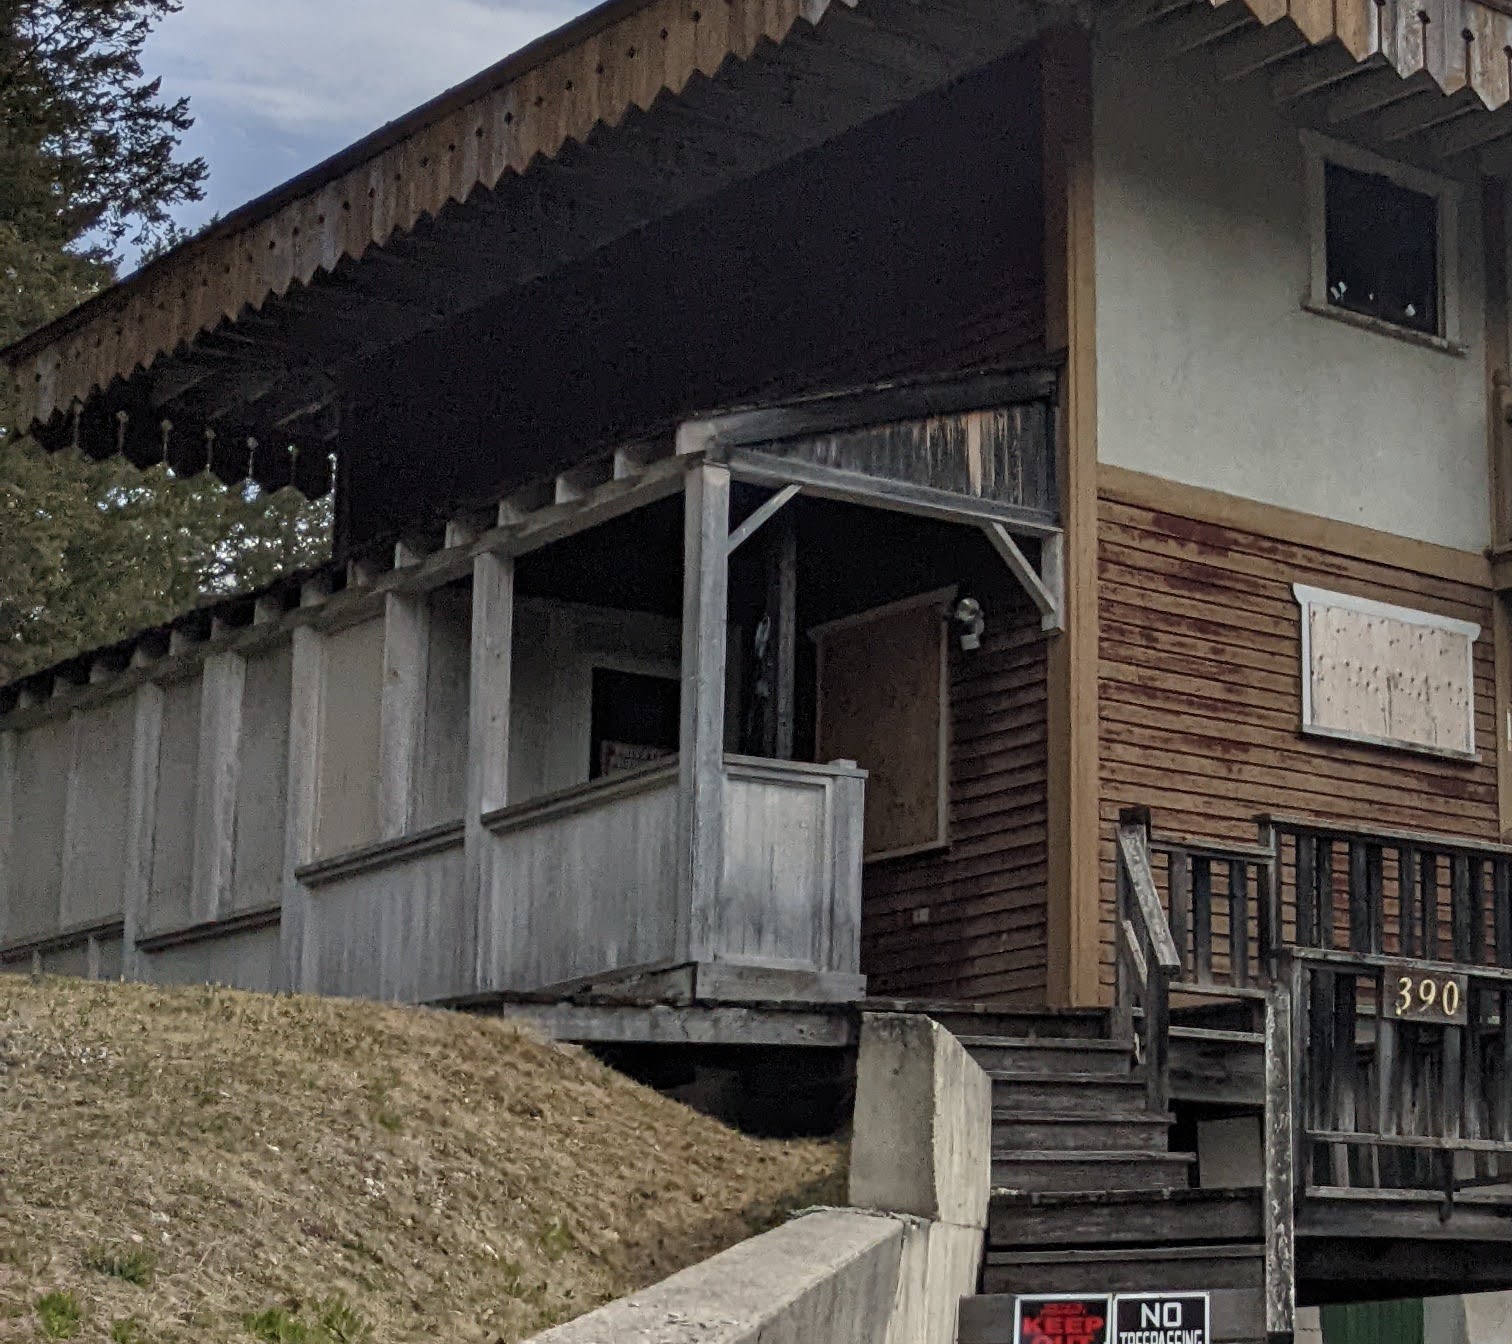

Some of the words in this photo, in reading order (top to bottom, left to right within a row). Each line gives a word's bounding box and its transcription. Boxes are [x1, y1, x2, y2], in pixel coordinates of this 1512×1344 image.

[1395, 977, 1459, 1016] 390
[1023, 1316, 1104, 1335] KEEP
[1141, 1302, 1182, 1328] NO
